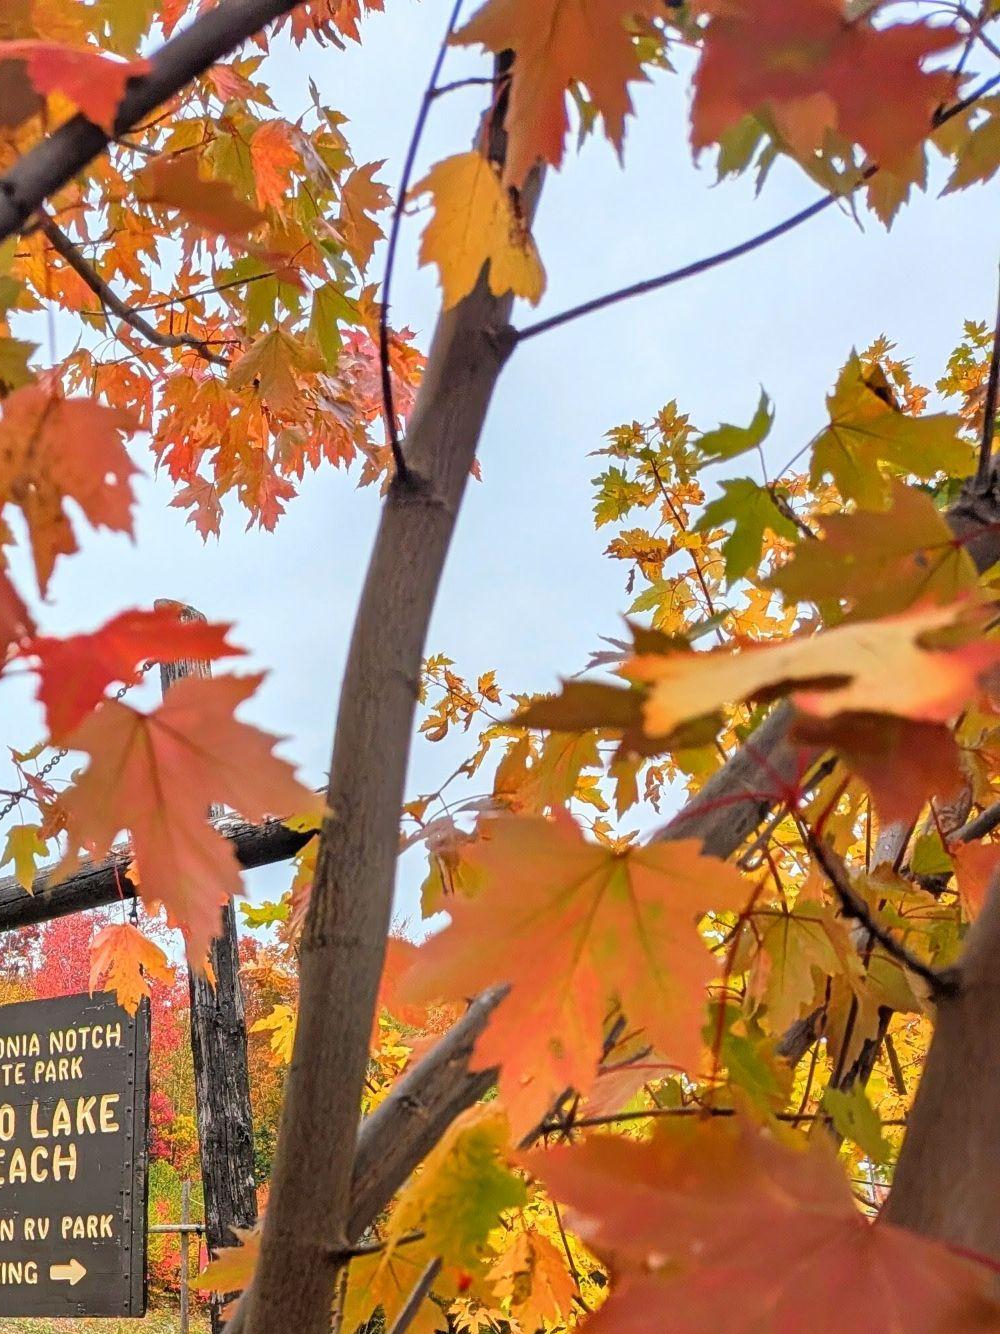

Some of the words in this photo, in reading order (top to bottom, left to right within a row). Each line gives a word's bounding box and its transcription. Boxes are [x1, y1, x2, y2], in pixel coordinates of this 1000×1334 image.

[49, 1022, 121, 1055] NOTCH
[34, 1056, 83, 1084] PARK
[30, 1093, 120, 1139] LAKE
[24, 1217, 50, 1241] RV
[61, 1214, 114, 1239] PARK
